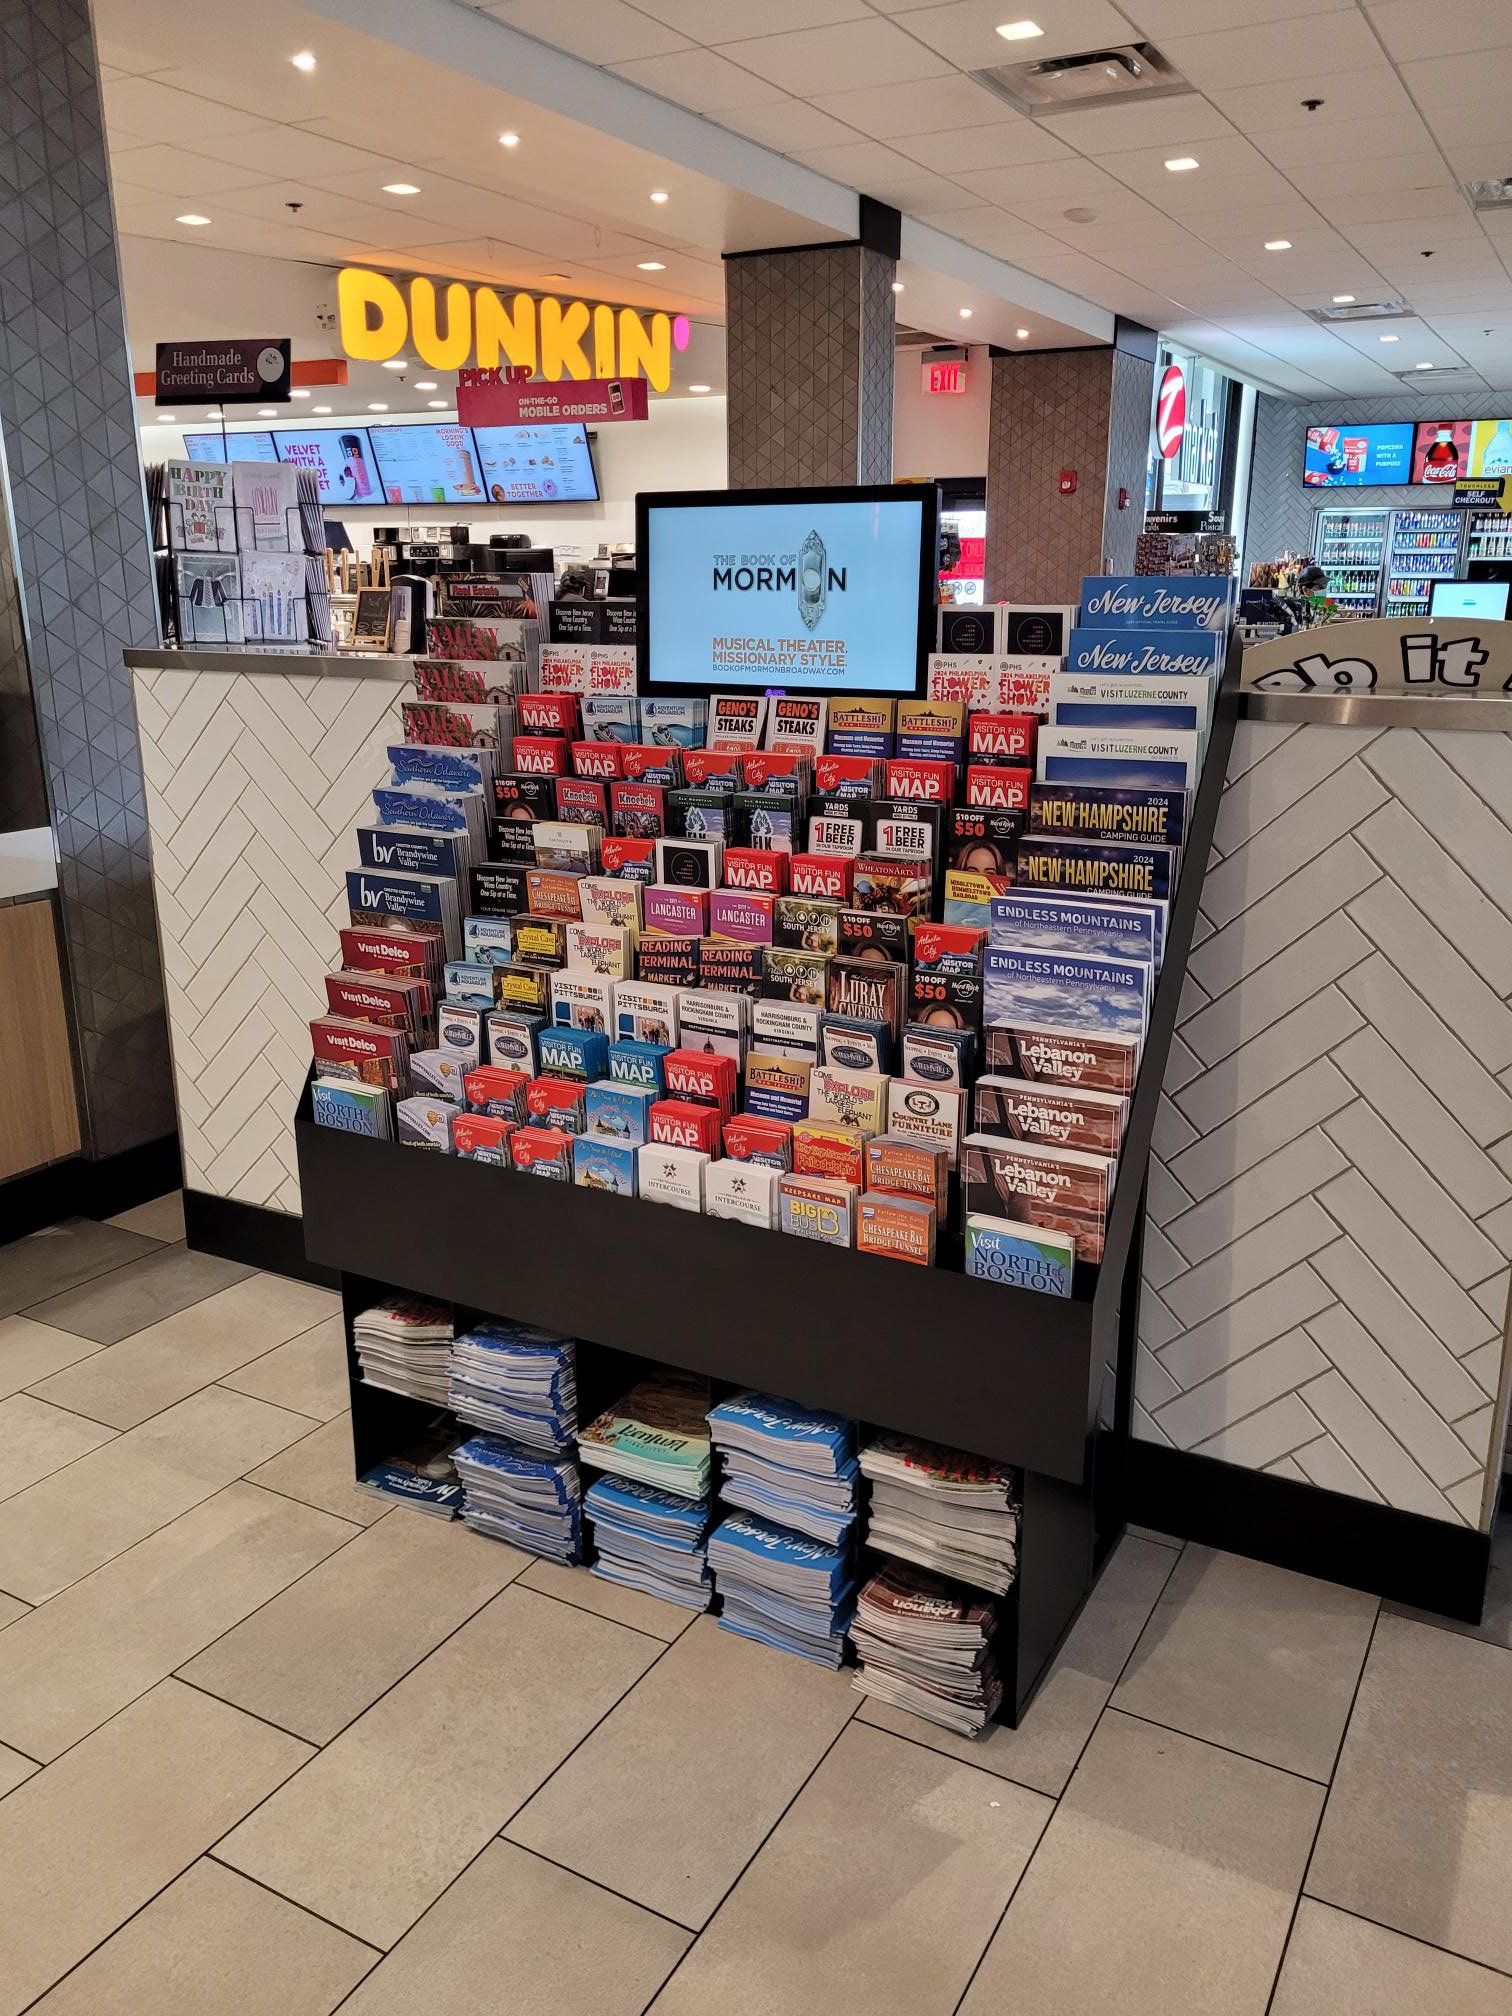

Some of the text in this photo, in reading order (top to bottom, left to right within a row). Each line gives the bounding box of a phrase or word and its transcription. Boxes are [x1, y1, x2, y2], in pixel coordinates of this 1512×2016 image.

[173, 349, 241, 367] Handmade
[161, 368, 254, 388] Greeting Cards
[459, 365, 532, 387] PICK UP
[931, 365, 958, 392] EXIT
[519, 397, 558, 405] ON-THE-GO
[519, 403, 607, 417] MOBILE ORDERS
[285, 445, 320, 454] VELVET
[289, 457, 325, 466] WITH A
[169, 467, 226, 483] HAPPY
[174, 484, 223, 498] BIRTH
[507, 490, 543, 498] TOGETHER
[186, 500, 214, 513] DAY
[714, 555, 797, 565] THE BOOK OF
[1088, 584, 1220, 627] New Jersey
[713, 637, 847, 653] MUSICAL THEATER.
[713, 652, 847, 666] MISSIONARY STYLE.
[1078, 639, 1209, 675] New Jersey
[1400, 633, 1489, 687] it
[590, 667, 631, 678] FLOWER
[713, 665, 845, 675] BOOKOFMORMONBROADWAY.COM
[591, 678, 620, 688] SHOW
[933, 677, 989, 690] FLOWER
[933, 690, 973, 701] SHOW
[1101, 689, 1188, 699] VISIT LUZERNE COUNTY
[521, 703, 558, 713] VISITOR FUN
[718, 702, 756, 716] GENO'S
[523, 710, 560, 727] MAP
[902, 715, 957, 729] BATTLESHIP
[718, 719, 753, 733] STEAKS
[974, 725, 1025, 735] VISITOR FUN
[973, 733, 1025, 754] MAP
[398, 758, 472, 777] Southern Delaware
[824, 773, 836, 785] City
[563, 788, 597, 803] Knoebels
[840, 786, 868, 794] VISITOR
[825, 803, 848, 811] YARDS
[1147, 797, 1168, 805] 2024
[1042, 801, 1168, 833] NEW HAMPSHIRE
[815, 823, 824, 842] 1
[827, 823, 855, 834] FREE
[955, 823, 984, 836] $50
[826, 833, 854, 845] BEER
[1101, 832, 1166, 843] CAMPING GUIDE
[373, 834, 395, 863] bv
[397, 848, 438, 861] Brandywine
[399, 858, 419, 869] Valley
[727, 861, 772, 871] VISITOR FUN
[1133, 856, 1154, 864] 2024
[728, 868, 773, 888] MAP
[1029, 856, 1153, 891] NEW HAMPSHIRE
[651, 903, 696, 919] LANCASTER
[997, 906, 1141, 932] ENDLESS MOUNTAINS
[783, 921, 829, 935] SOUTH JERSEY
[1024, 920, 1071, 933] Northeastern
[1073, 925, 1123, 939] Pennsylvania
[518, 933, 554, 944] Crystal Cave
[641, 941, 691, 952] READING
[640, 955, 696, 969] TERMINAL
[648, 972, 681, 984] MARKET
[991, 957, 1134, 985] ENDLESS MOUNTAINS
[554, 990, 603, 1001] PITTSBURGH
[840, 971, 886, 1007] LURAY
[761, 1012, 801, 1023] HARRISONBURG
[839, 1002, 884, 1020] CAVERNS
[756, 1018, 812, 1031] ROCKINGHAM COUNTY
[542, 1040, 581, 1052] VISITOR FUN
[1032, 1036, 1085, 1048] PENNSYLVANIA'S
[542, 1047, 582, 1069] MAP
[1021, 1040, 1096, 1065] Lebanon
[1032, 1057, 1083, 1081] Valley
[750, 1067, 805, 1088] BATTLESHIP
[313, 1087, 331, 1100] Visit
[316, 1100, 363, 1120] NORTH
[1008, 1099, 1084, 1125] Lebanon
[318, 1113, 373, 1134] BOSTON
[893, 1112, 952, 1129] COUNTRY LANE
[892, 1121, 952, 1137] FURNITURE
[1018, 1116, 1071, 1140] Valley
[1006, 1155, 1060, 1169] PENNSYLVANIA'S
[994, 1159, 1071, 1188] Lebanon
[649, 1181, 691, 1196] INTERCOURSE
[784, 1187, 842, 1204] KEEPSAKE MAP
[1006, 1177, 1057, 1202] Valley
[715, 1196, 760, 1211] INTERCOURSE
[791, 1200, 816, 1217] BIG
[791, 1216, 816, 1230] BUS
[863, 1221, 924, 1245] CHESAPEAKE BAY
[971, 1232, 1001, 1249] Visit
[974, 1248, 1050, 1274] NORTH
[974, 1261, 1064, 1295] BOSTON
[893, 1600, 959, 1617] Lebanon
